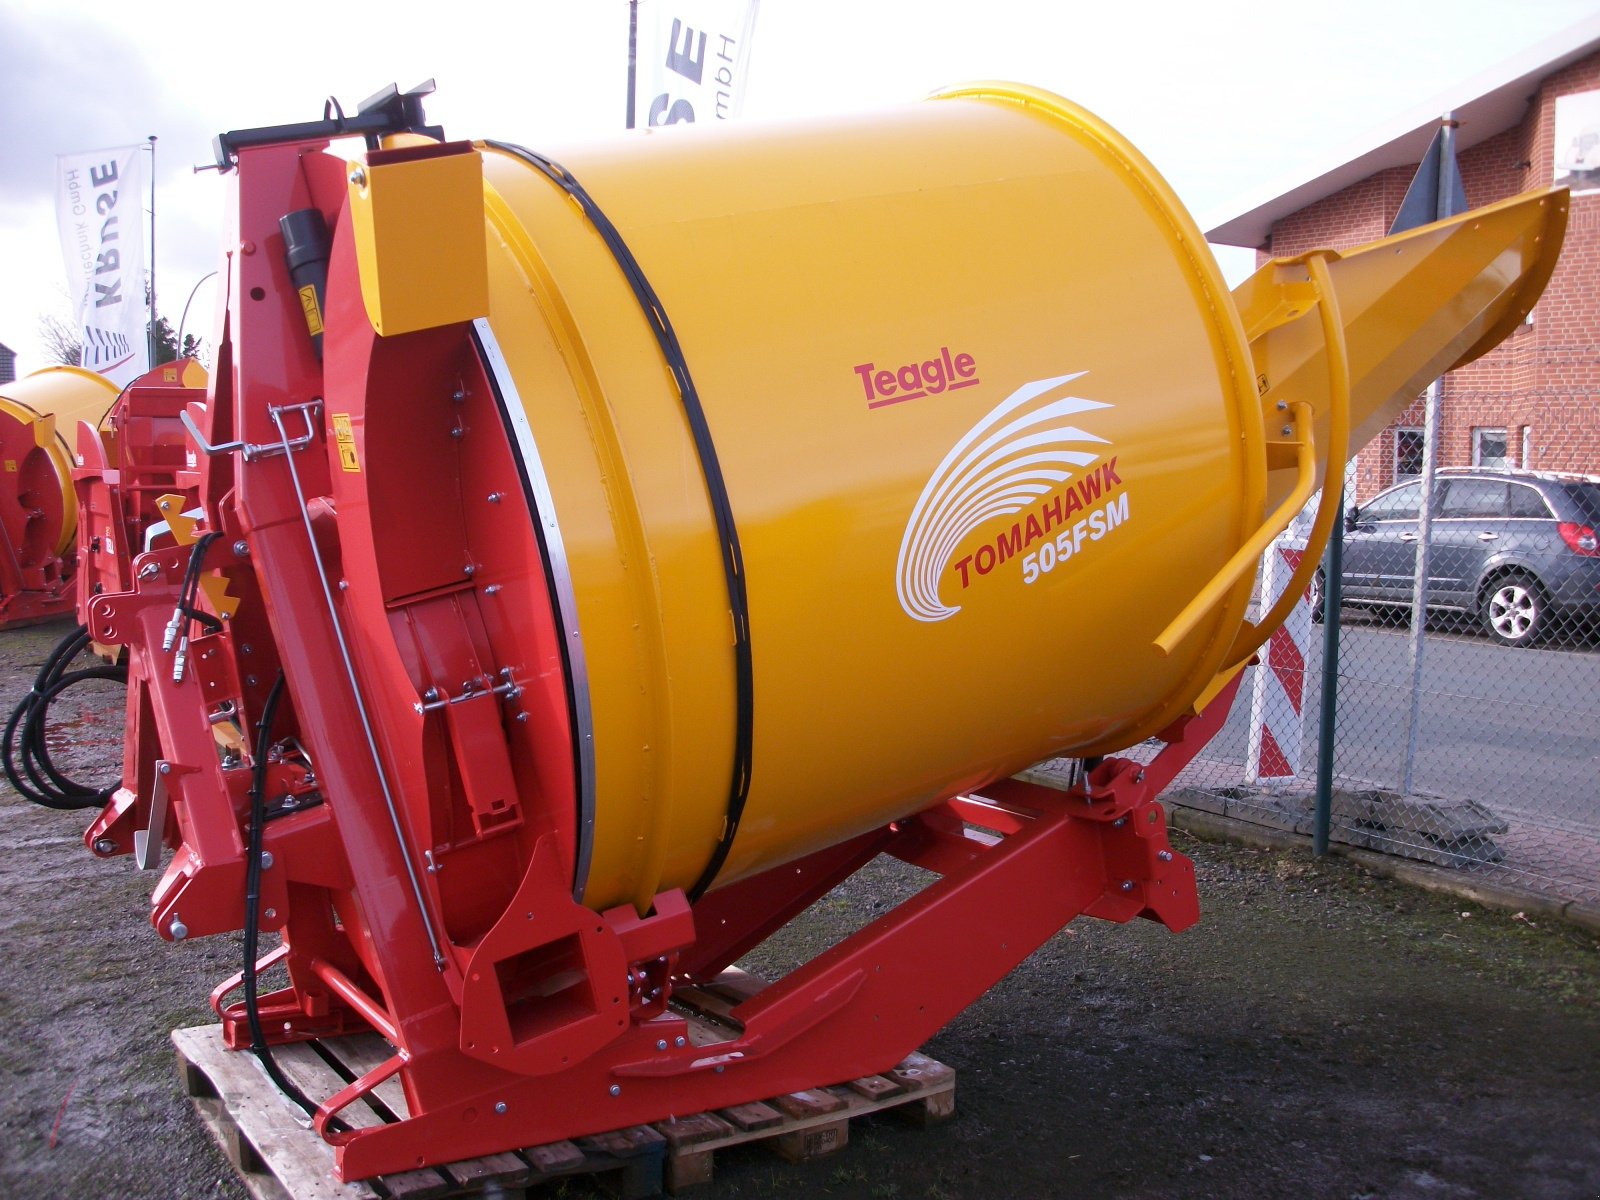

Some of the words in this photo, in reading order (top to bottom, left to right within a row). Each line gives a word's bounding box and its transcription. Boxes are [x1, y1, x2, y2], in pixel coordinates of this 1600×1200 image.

[854, 347, 977, 402] Teagle
[954, 456, 1122, 589] TOMAHAWK
[1022, 492, 1130, 584] 505FSM
